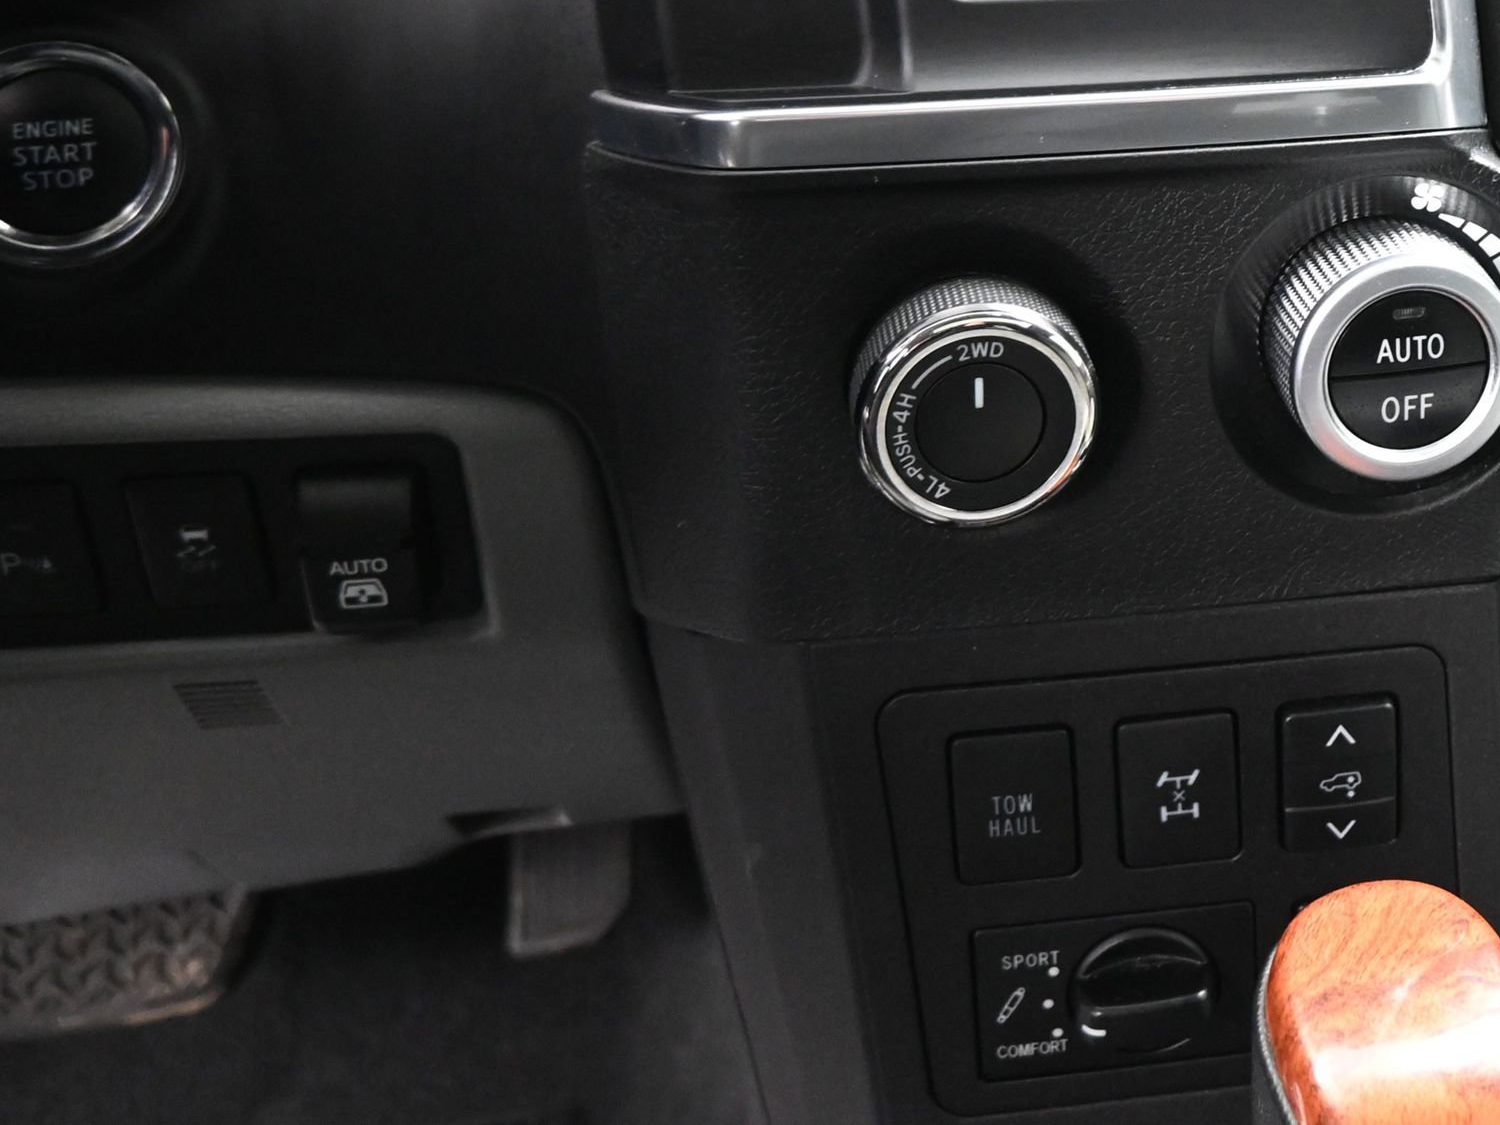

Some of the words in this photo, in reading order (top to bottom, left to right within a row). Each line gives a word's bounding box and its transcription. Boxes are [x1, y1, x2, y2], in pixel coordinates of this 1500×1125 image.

[12, 118, 94, 140] ENGINE
[13, 141, 97, 167] START
[23, 167, 94, 191] STOP
[956, 341, 1005, 362] 2WD
[1376, 333, 1445, 364] AUTO
[1380, 392, 1435, 424] OFF
[329, 558, 388, 576] AUTO
[992, 793, 1033, 815] TOW
[989, 817, 1041, 838] HAUL
[1001, 950, 1060, 970] SPORT
[997, 1038, 1069, 1059] COMFORT
